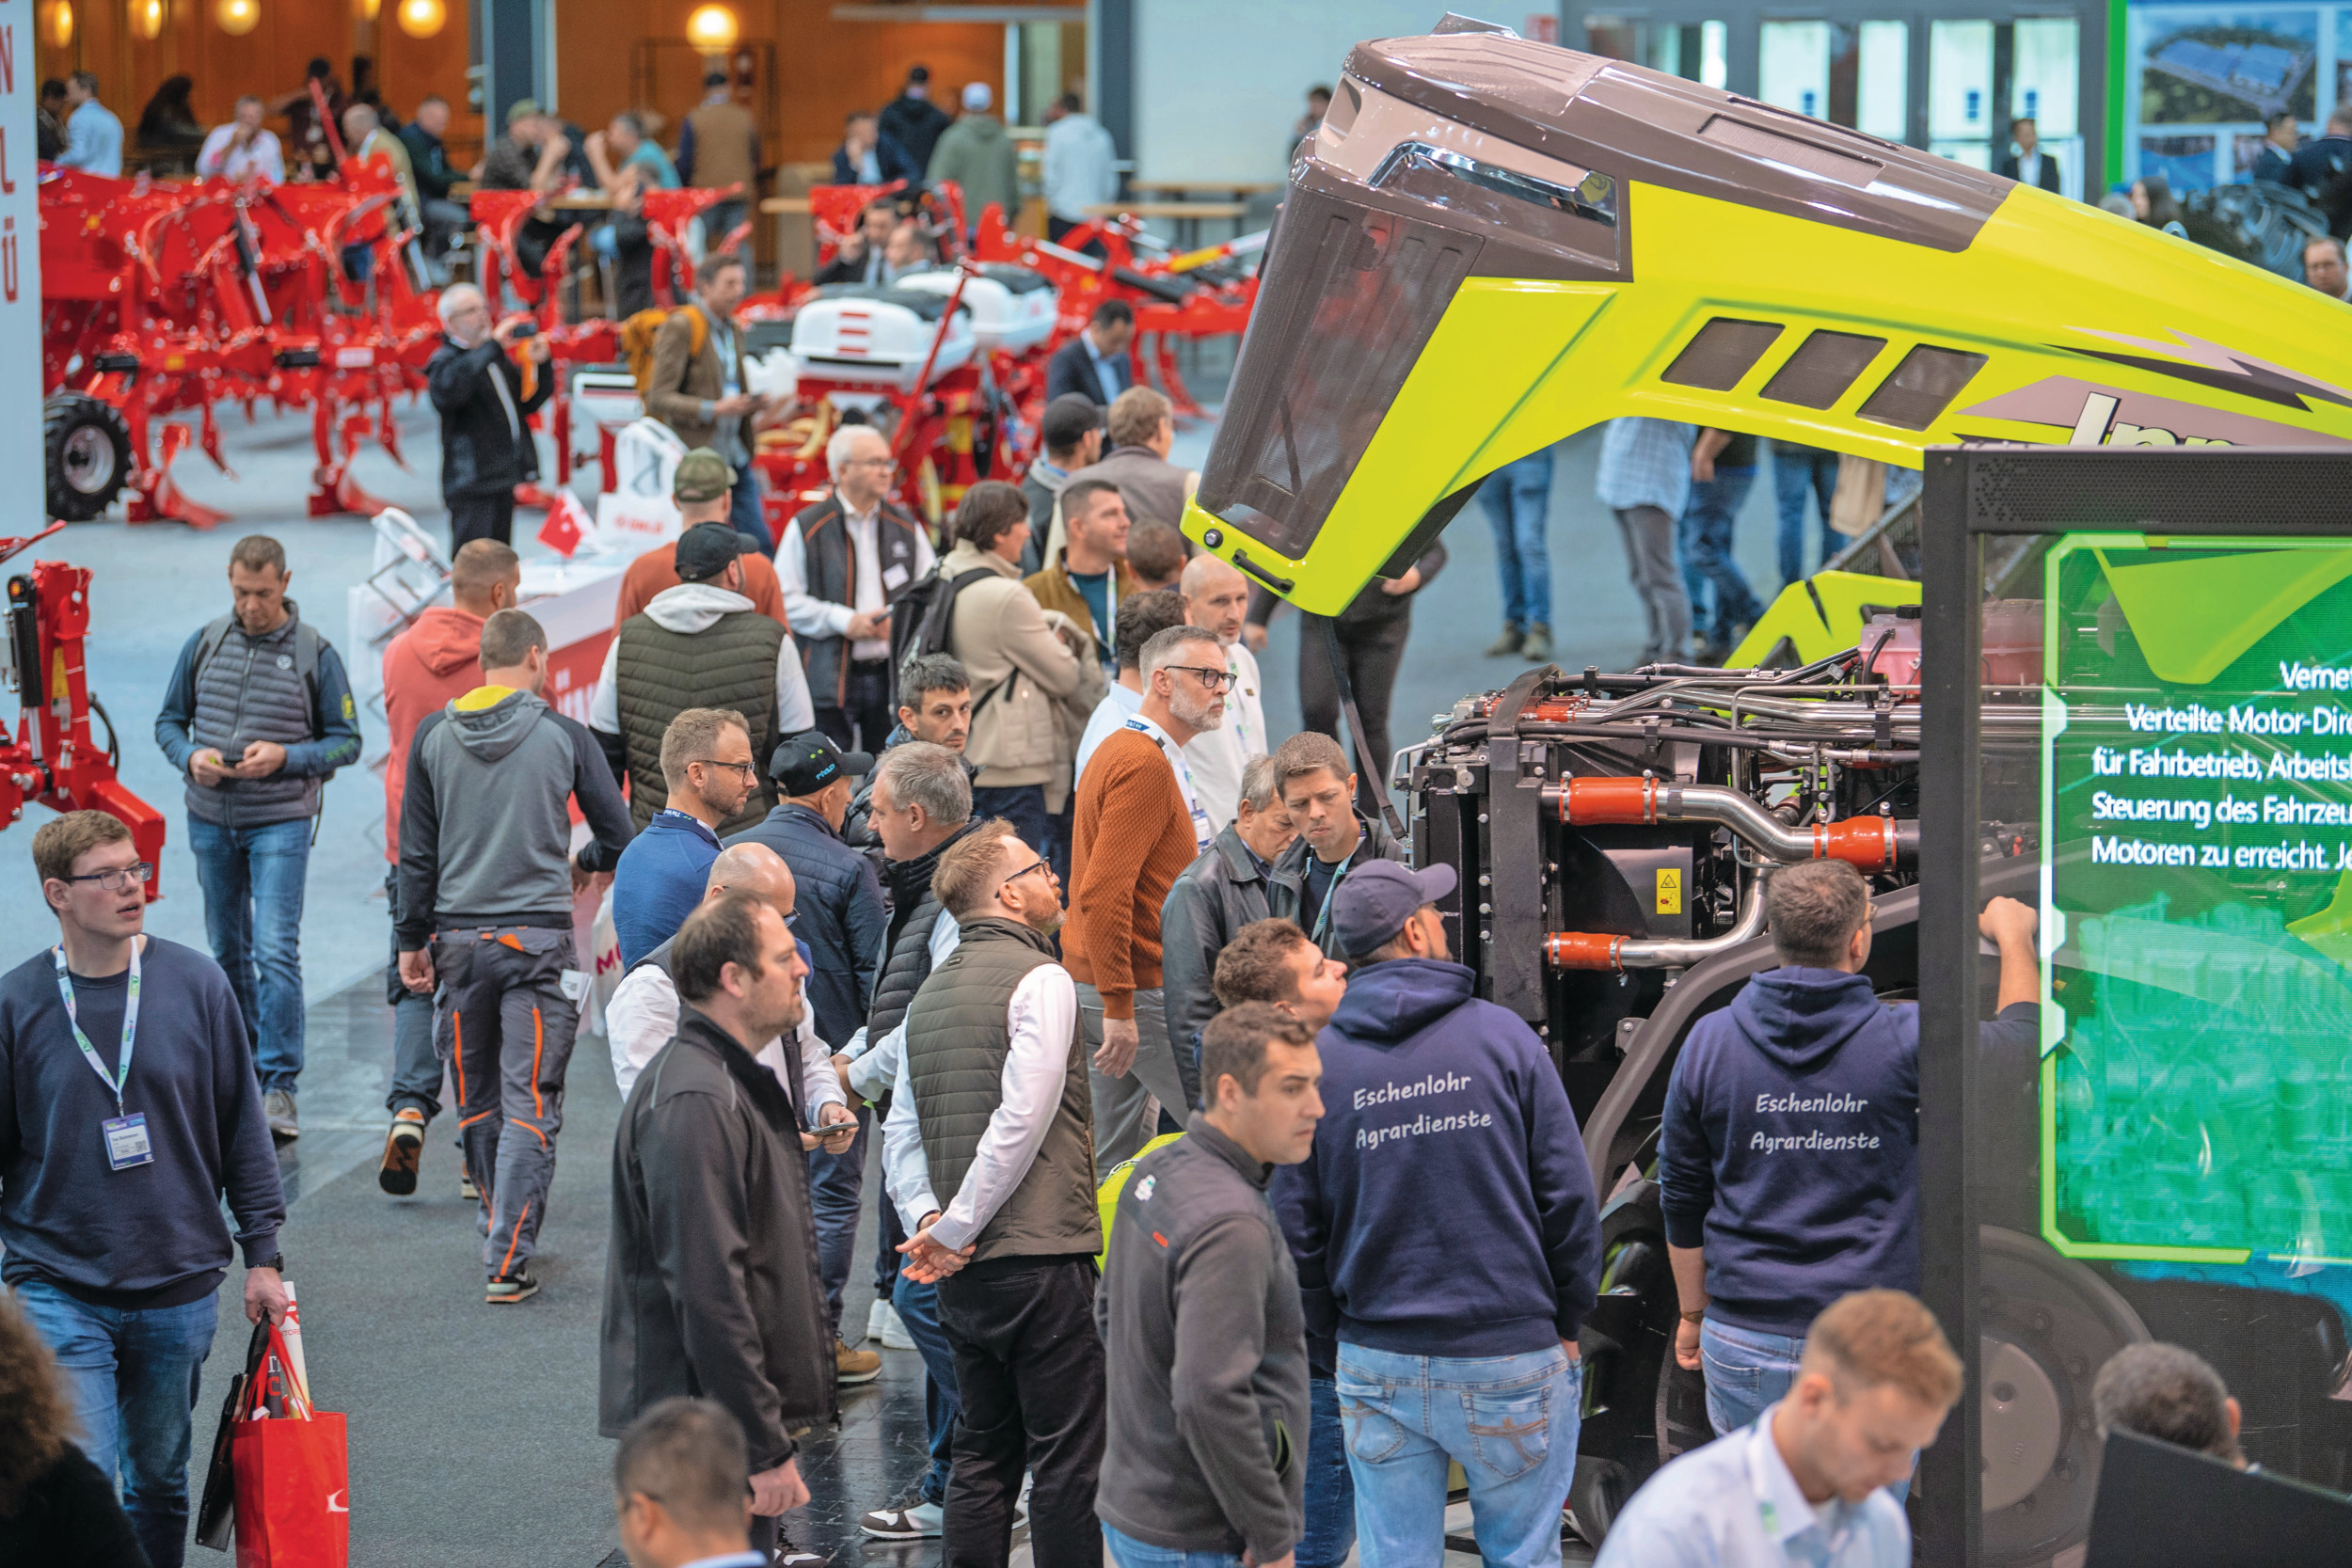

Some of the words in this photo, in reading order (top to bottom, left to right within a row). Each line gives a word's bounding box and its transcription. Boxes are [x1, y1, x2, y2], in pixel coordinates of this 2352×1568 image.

[0, 0, 18, 302] NLÜ
[2279, 660, 2352, 690] Verne
[2124, 703, 2224, 733] Verteilte
[2092, 746, 2127, 776] für
[2128, 747, 2264, 782] Fahrbetrieb,
[2266, 750, 2352, 781] Arbeits
[2091, 791, 2212, 830] Steuerung
[2215, 793, 2259, 824] des
[2091, 835, 2196, 865] Motoren
[2199, 845, 2230, 867] zu
[1353, 1071, 1472, 1110] Eschenlohr
[1756, 1092, 1869, 1113] Eschenlohr
[1356, 1110, 1493, 1150] Agrardienste
[1749, 1130, 1881, 1155] Agrardienste
